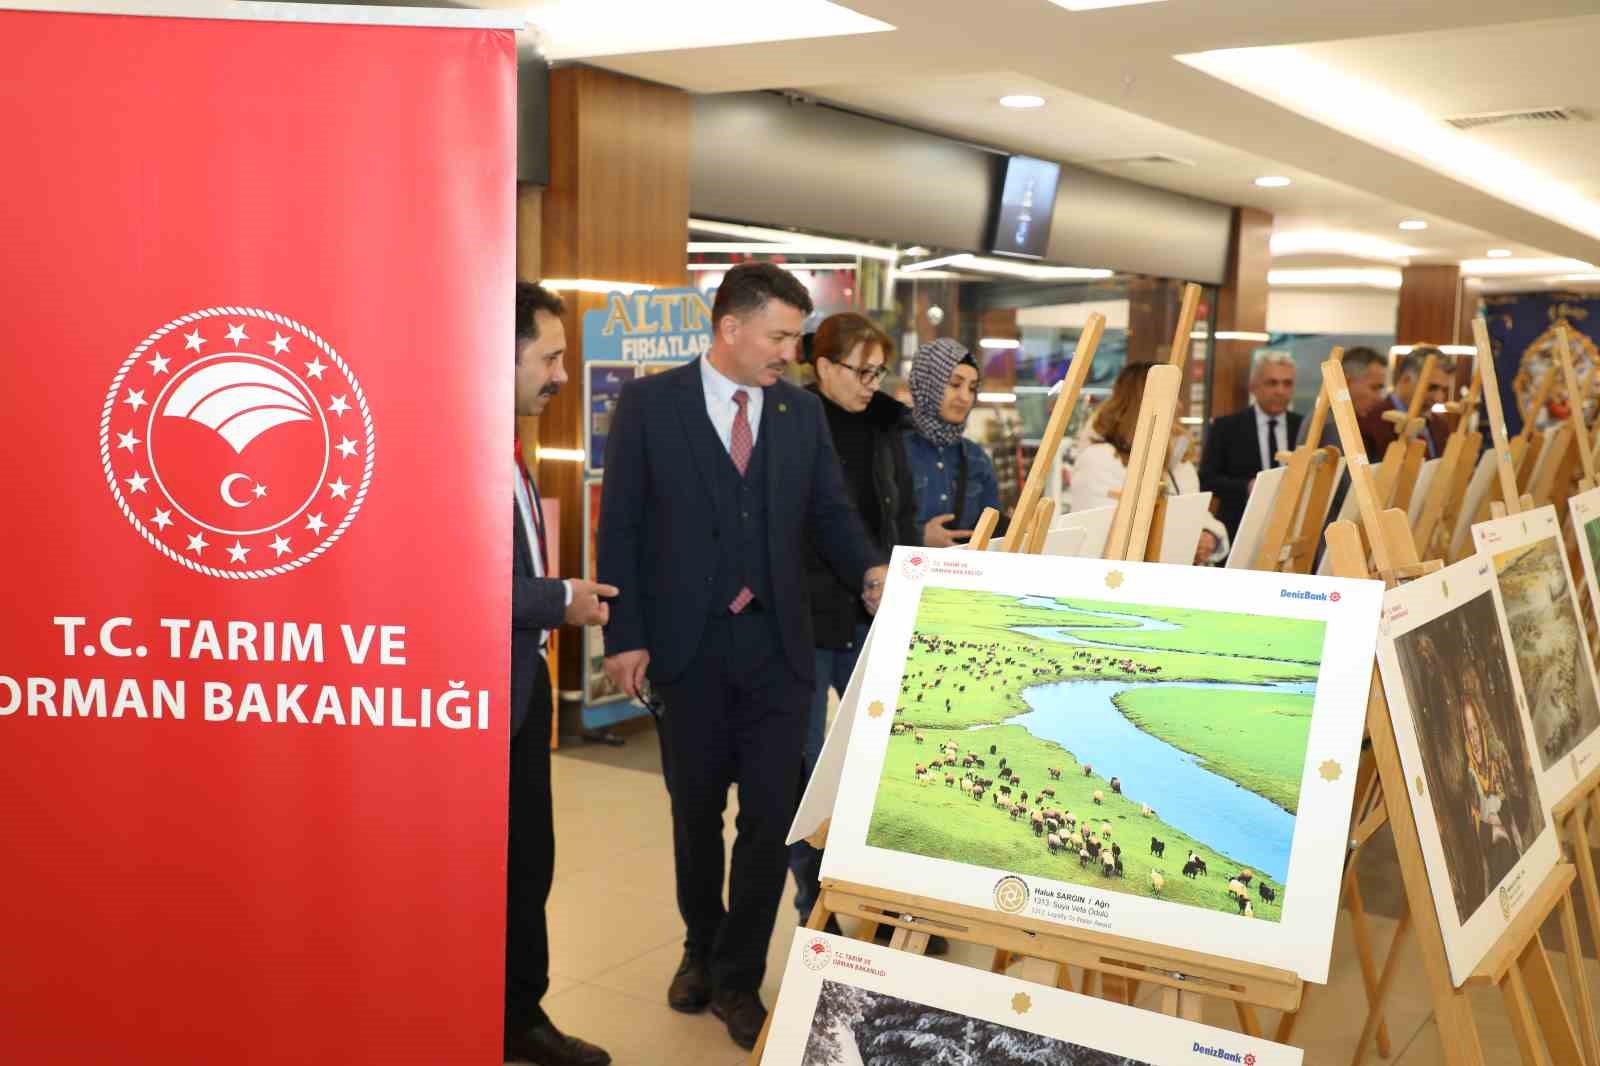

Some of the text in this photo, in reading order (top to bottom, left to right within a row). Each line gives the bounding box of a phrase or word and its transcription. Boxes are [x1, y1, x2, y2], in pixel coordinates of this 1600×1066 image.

[1280, 589, 1328, 601] DenizBank
[54, 616, 407, 665] T.C. TARIM VE
[0, 675, 490, 730] ORMAN BAKANLIĞI
[1034, 888, 1055, 898] Haluk
[1056, 891, 1086, 903] SARGIN
[833, 959, 854, 969] ORMAN
[845, 953, 863, 963] TARIM
[1193, 1042, 1242, 1063] DenizBank
